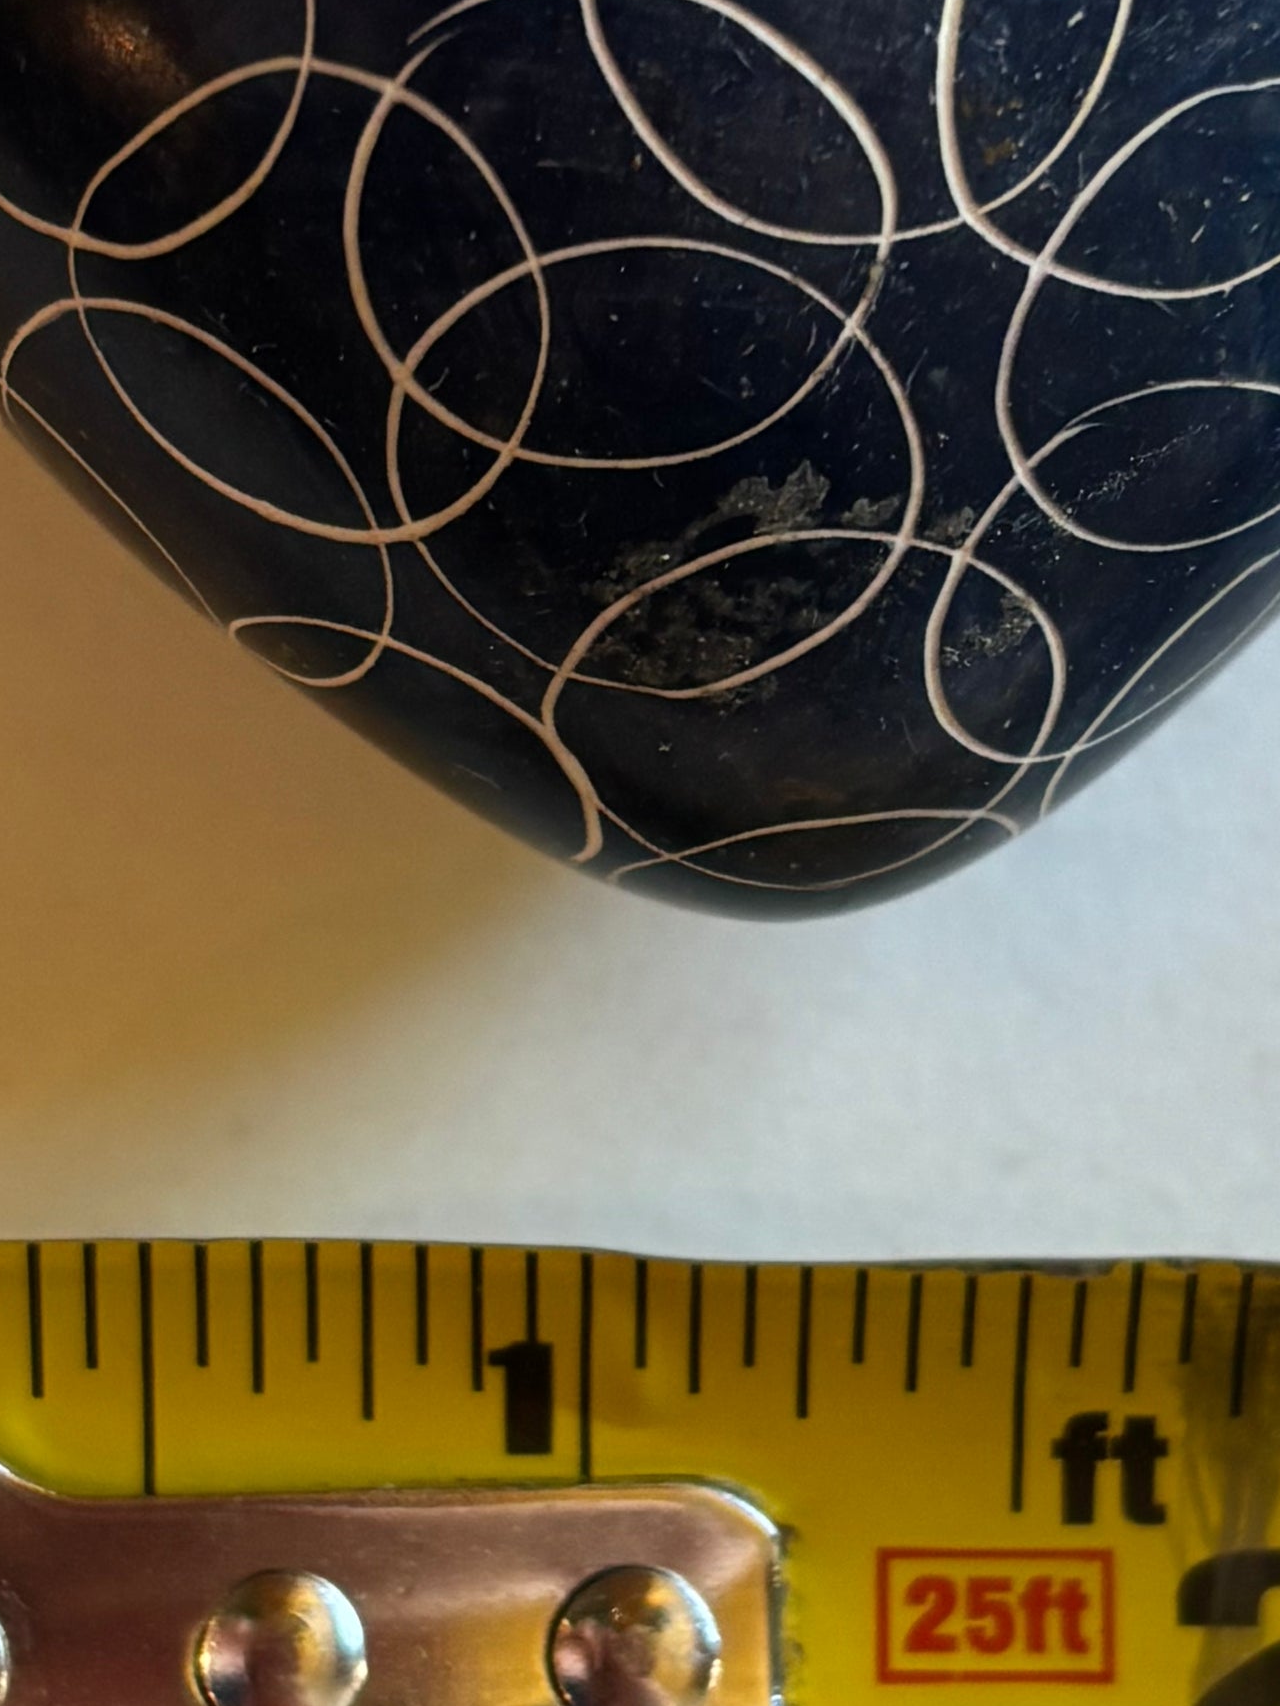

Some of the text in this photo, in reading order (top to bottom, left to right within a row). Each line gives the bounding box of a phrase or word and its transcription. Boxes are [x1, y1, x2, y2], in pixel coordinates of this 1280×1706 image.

[487, 1340, 554, 1455] 1
[1051, 1410, 1171, 1526] ft
[902, 1575, 1091, 1655] 25ft
